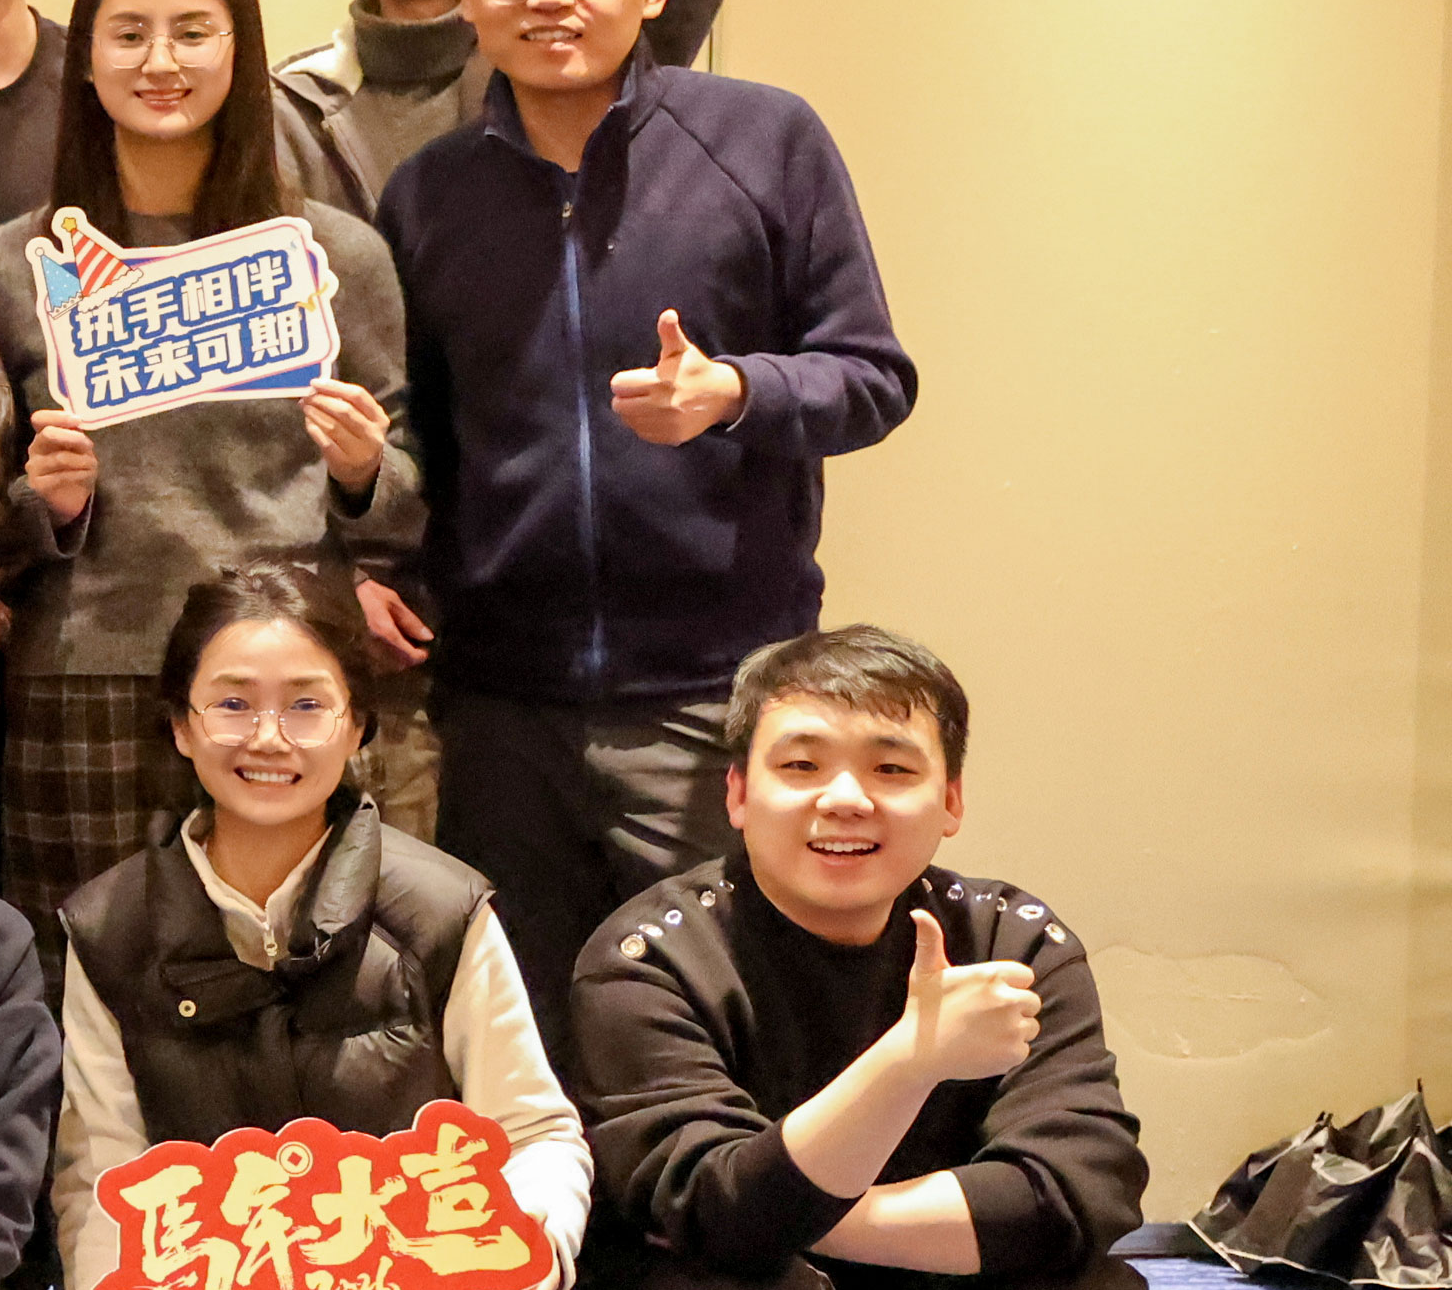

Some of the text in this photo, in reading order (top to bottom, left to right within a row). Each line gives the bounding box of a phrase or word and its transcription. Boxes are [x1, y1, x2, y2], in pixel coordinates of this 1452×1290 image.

[76, 253, 287, 349] 执手相伴
[91, 311, 305, 400] 未来可期
